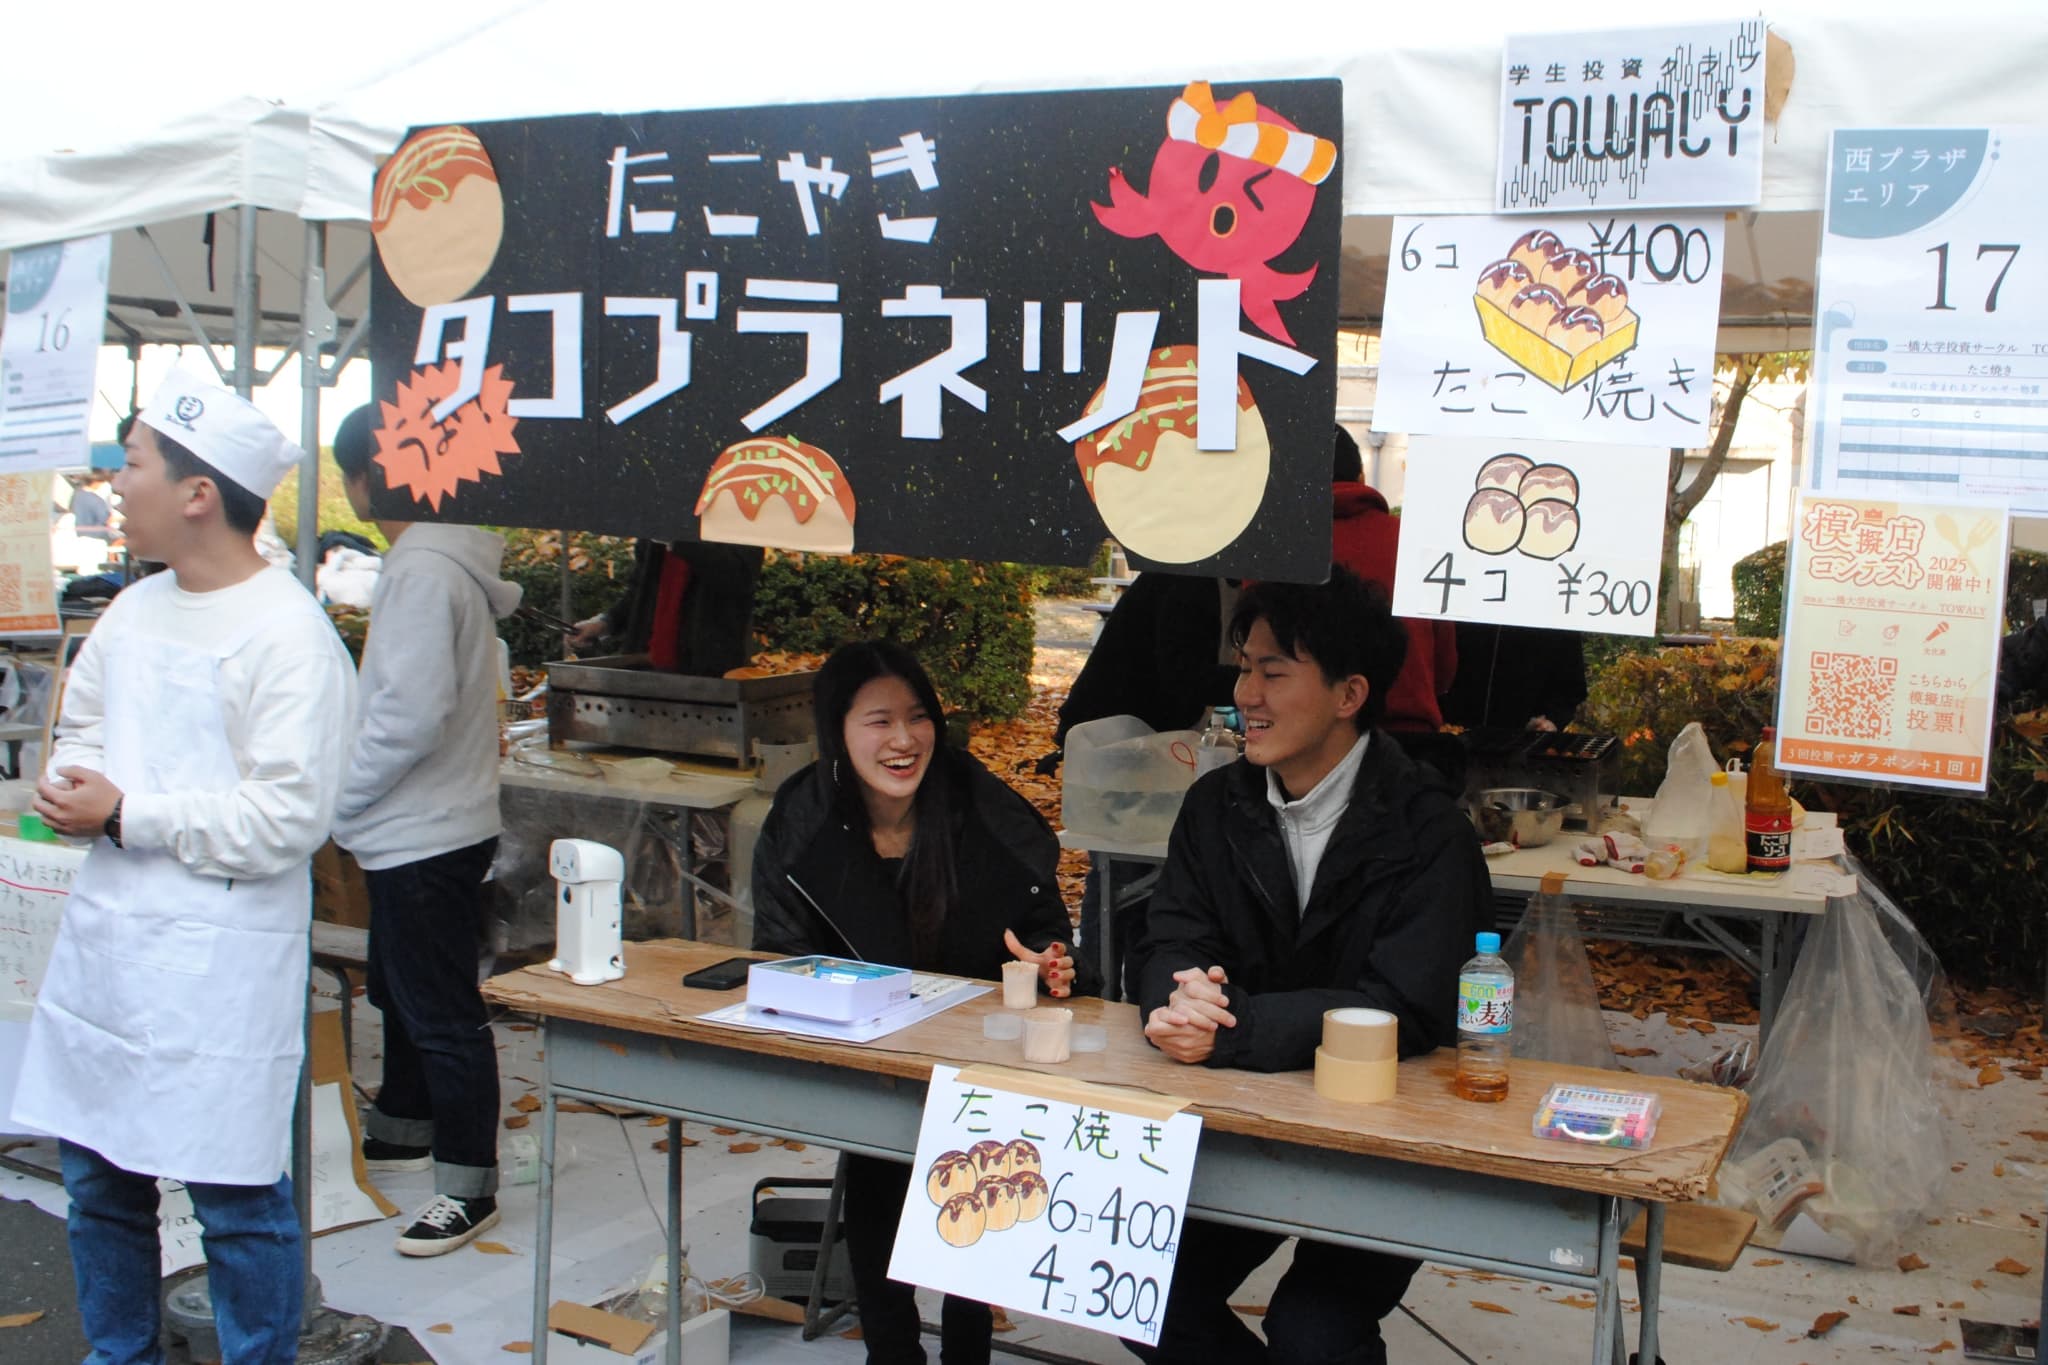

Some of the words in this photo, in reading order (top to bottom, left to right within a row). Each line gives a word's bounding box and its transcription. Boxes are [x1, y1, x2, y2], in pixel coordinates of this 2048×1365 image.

[1513, 87, 1751, 166] TOWALY
[1845, 147, 1967, 174] 西プラザ
[605, 131, 940, 243] たこやき
[1843, 182, 1930, 208] エリア
[1401, 223, 1460, 272] 6コ
[1588, 219, 1711, 284] ¥400
[1924, 241, 2021, 312] 17
[37, 306, 72, 354] 16
[414, 270, 1319, 452] タコプラネット
[1433, 343, 1702, 425] たこ焼き
[1967, 364, 2012, 377] たこ焼き
[1808, 507, 1920, 556] 模擬店
[1423, 552, 1507, 614] 4コ
[1558, 563, 1652, 618] ¥300
[1813, 557, 1921, 586] コンテスト
[1928, 556, 1968, 572] 2025
[1908, 674, 1968, 690] こちらから
[1479, 1000, 1512, 1026] 麦茶
[952, 1088, 1169, 1175] たこ焼き
